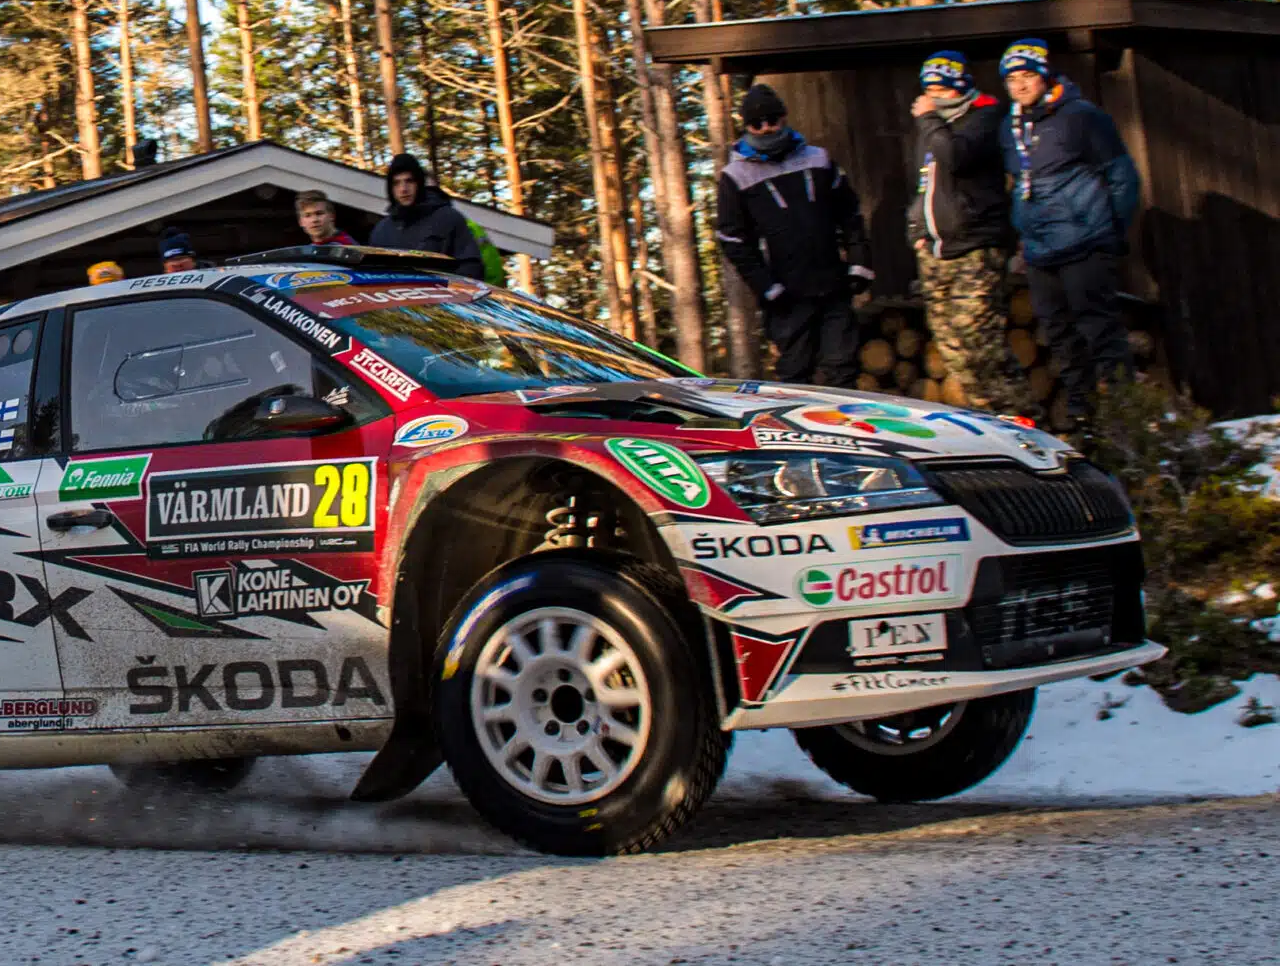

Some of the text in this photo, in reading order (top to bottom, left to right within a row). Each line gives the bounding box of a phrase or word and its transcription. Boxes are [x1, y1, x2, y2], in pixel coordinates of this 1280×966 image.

[129, 273, 205, 290] PESEBA
[263, 295, 342, 349] LAAKKONEN
[80, 467, 136, 490] Fennia
[617, 439, 702, 502] VIITA
[156, 462, 370, 528] VÄRMLAND 28
[184, 542, 199, 553] FIA
[200, 541, 226, 552] World
[227, 540, 250, 552] Rally
[251, 537, 315, 551] Championship
[691, 532, 836, 560] ŠKODA
[237, 569, 292, 592] KONE
[836, 560, 951, 602] Castrol
[237, 584, 365, 613] LAHTINEN OY
[125, 654, 387, 715] ŠKODA
